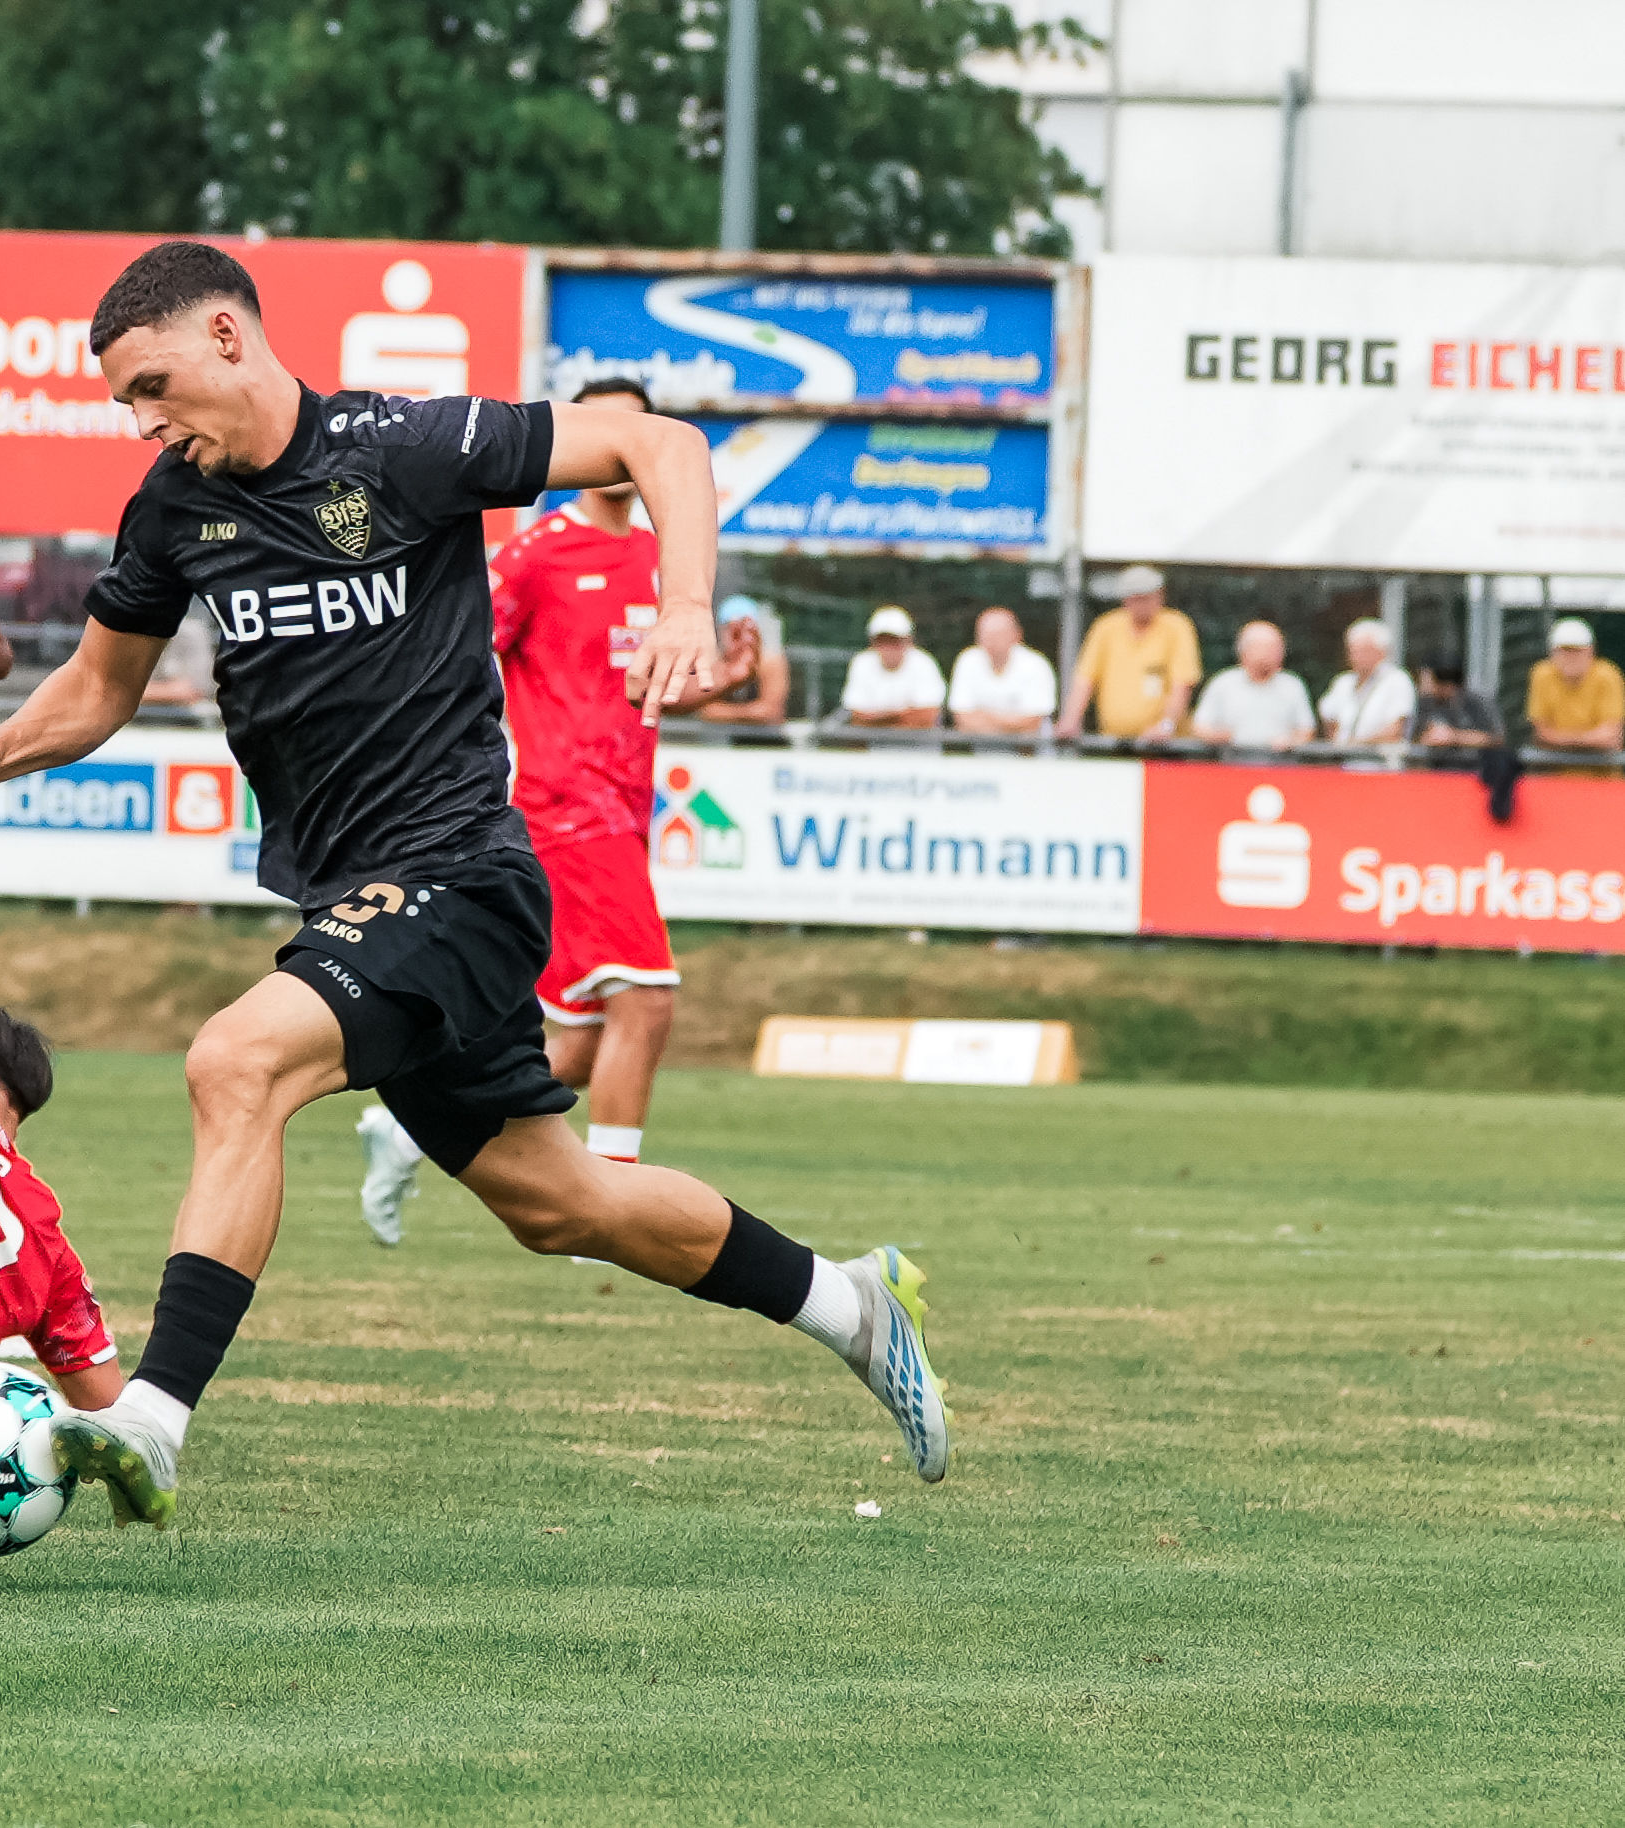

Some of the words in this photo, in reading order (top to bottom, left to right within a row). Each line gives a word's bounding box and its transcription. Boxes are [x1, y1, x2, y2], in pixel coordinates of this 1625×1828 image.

[1185, 333, 1399, 387] GEORG
[200, 522, 238, 541] JAKO
[771, 814, 1128, 879] Widmann
[1339, 847, 1625, 927] Sparkass
[312, 918, 364, 944] JAKO
[317, 959, 362, 999] JAKO
